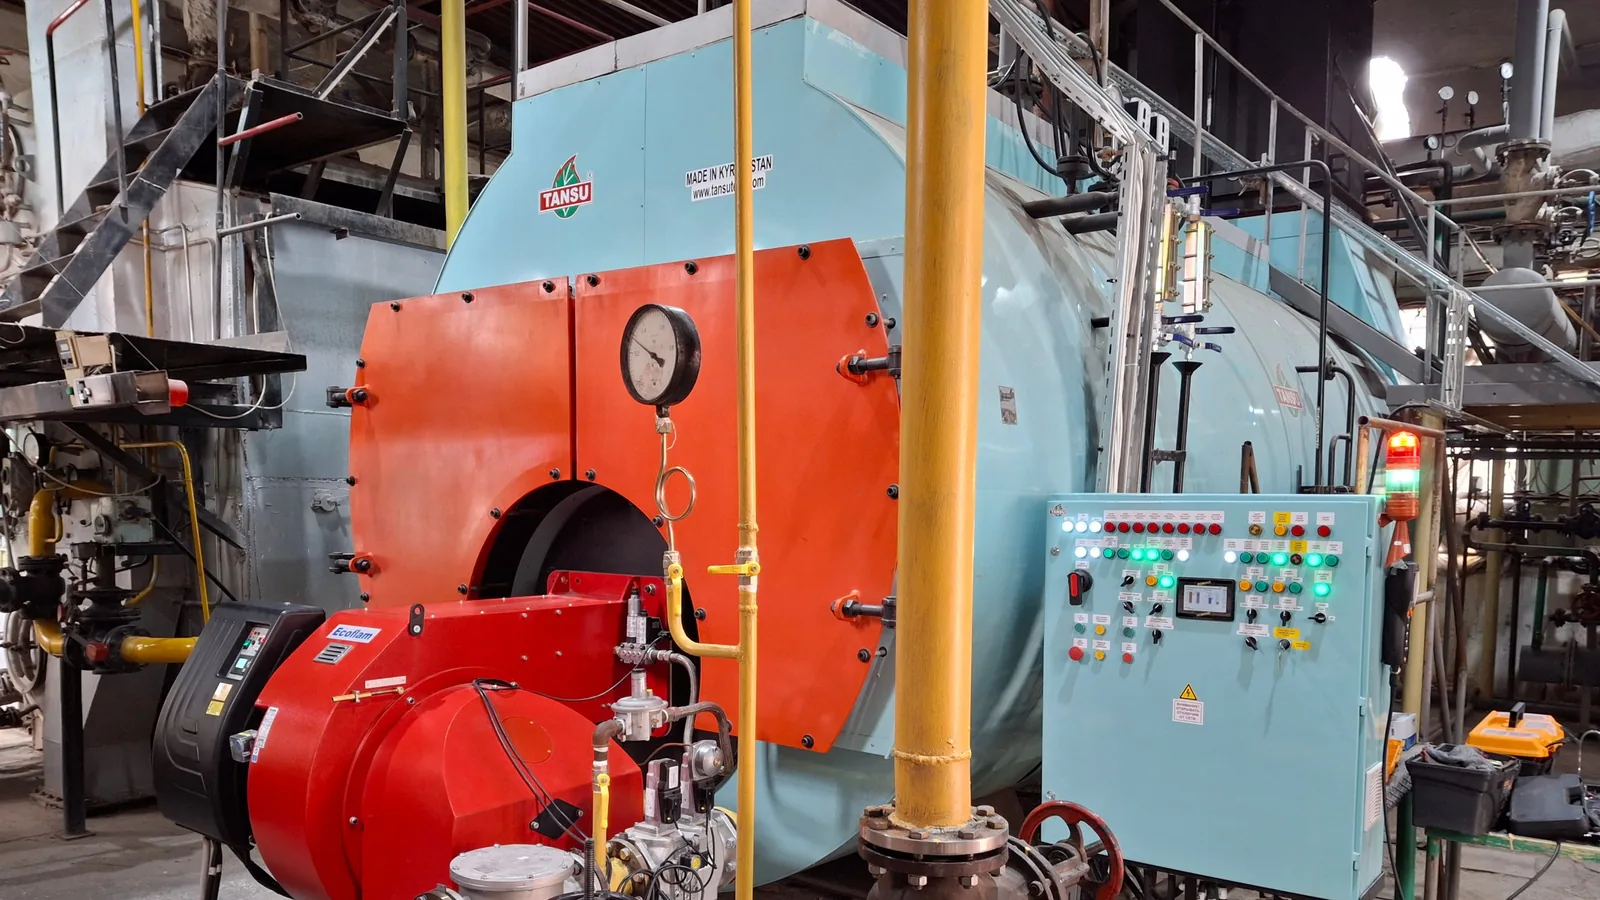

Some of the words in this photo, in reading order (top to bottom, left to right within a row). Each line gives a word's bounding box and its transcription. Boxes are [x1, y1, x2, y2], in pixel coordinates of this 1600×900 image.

[686, 169, 708, 186] MADE
[709, 166, 717, 181] IN
[719, 155, 772, 179] KYRSTAN
[542, 184, 589, 208] TANSU
[332, 627, 373, 640] Ecoflam
